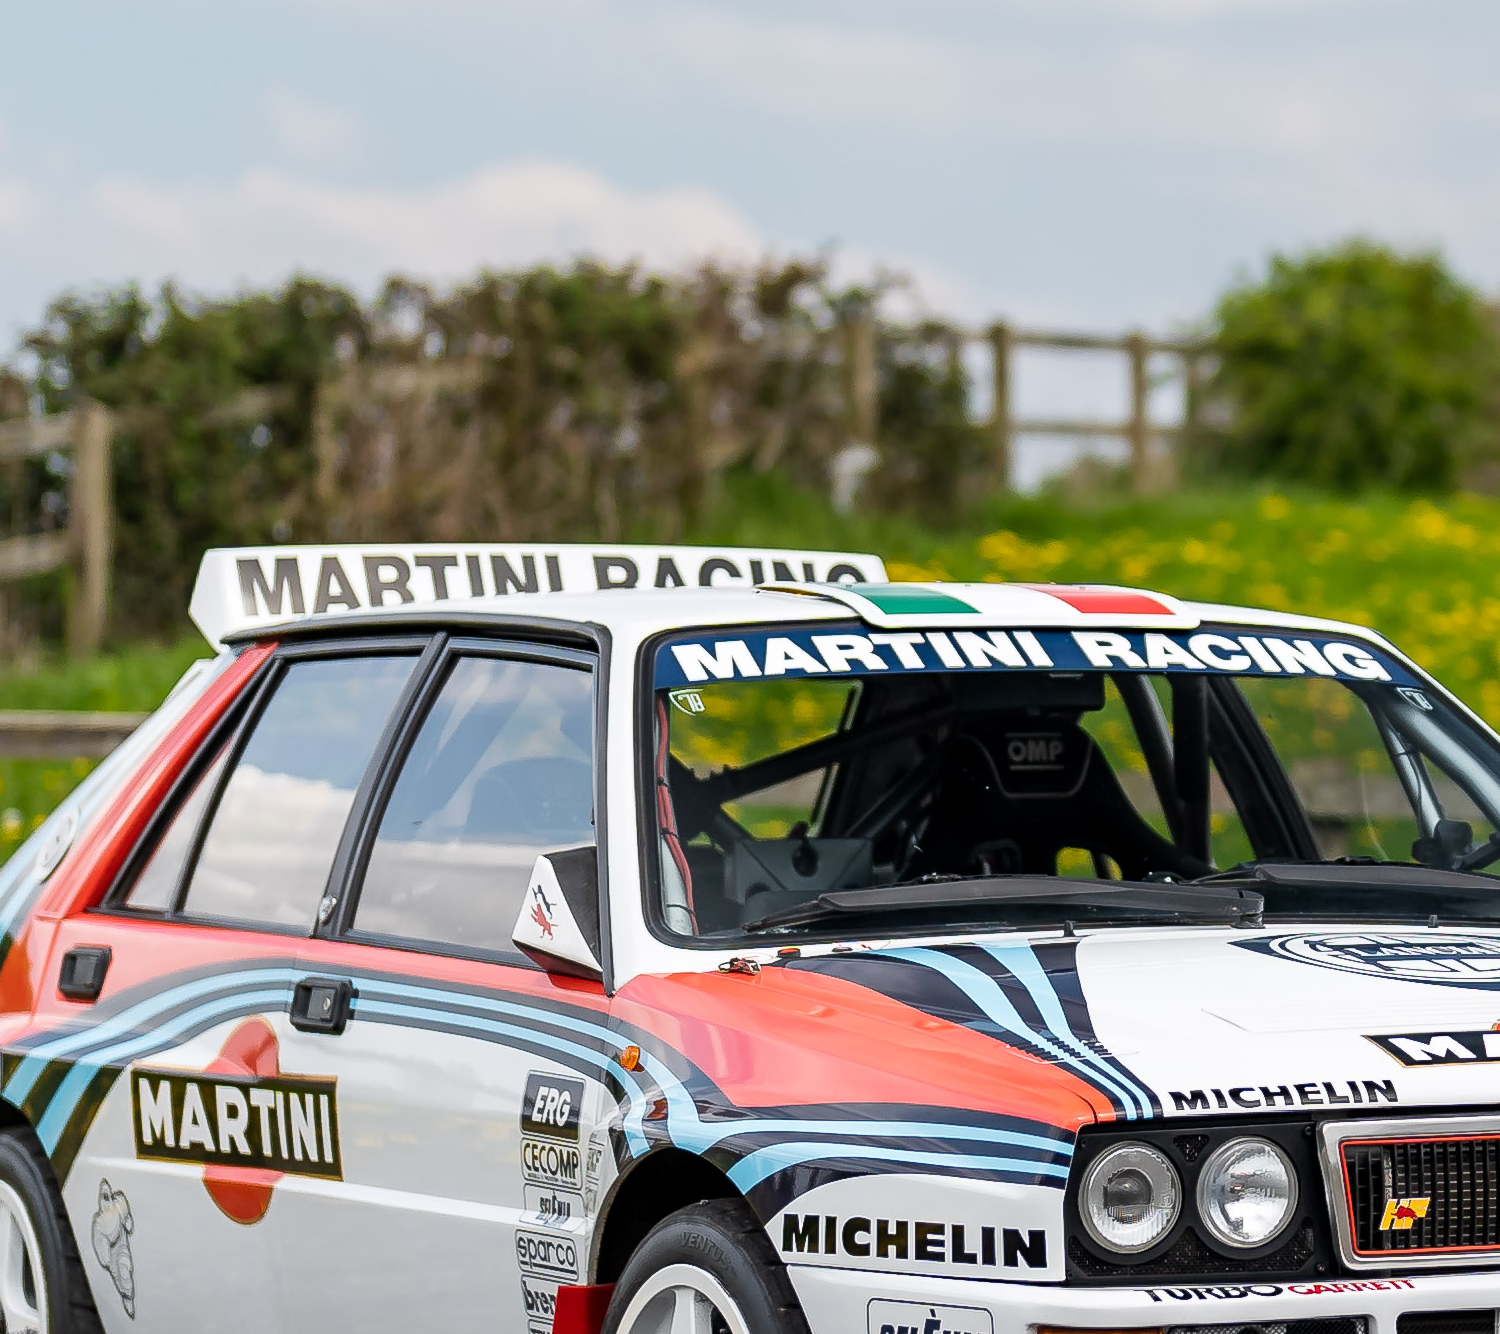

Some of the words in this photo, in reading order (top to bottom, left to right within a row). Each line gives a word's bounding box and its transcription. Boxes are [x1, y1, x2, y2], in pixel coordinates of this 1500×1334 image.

[234, 553, 565, 617] MARTINI
[669, 631, 1055, 683] MARTINI
[1071, 631, 1394, 683] RACING
[1008, 740, 1063, 762] OMP
[532, 1086, 571, 1127] ERG
[1168, 1079, 1399, 1110] MICHELIN
[138, 1077, 334, 1163] MARTINI
[523, 1145, 579, 1181] CECOMP
[517, 1234, 576, 1268] sparco
[782, 1213, 1048, 1268] MICHELIN
[1132, 1284, 1283, 1302] TURBO
[1287, 1279, 1416, 1295] GARRETT
